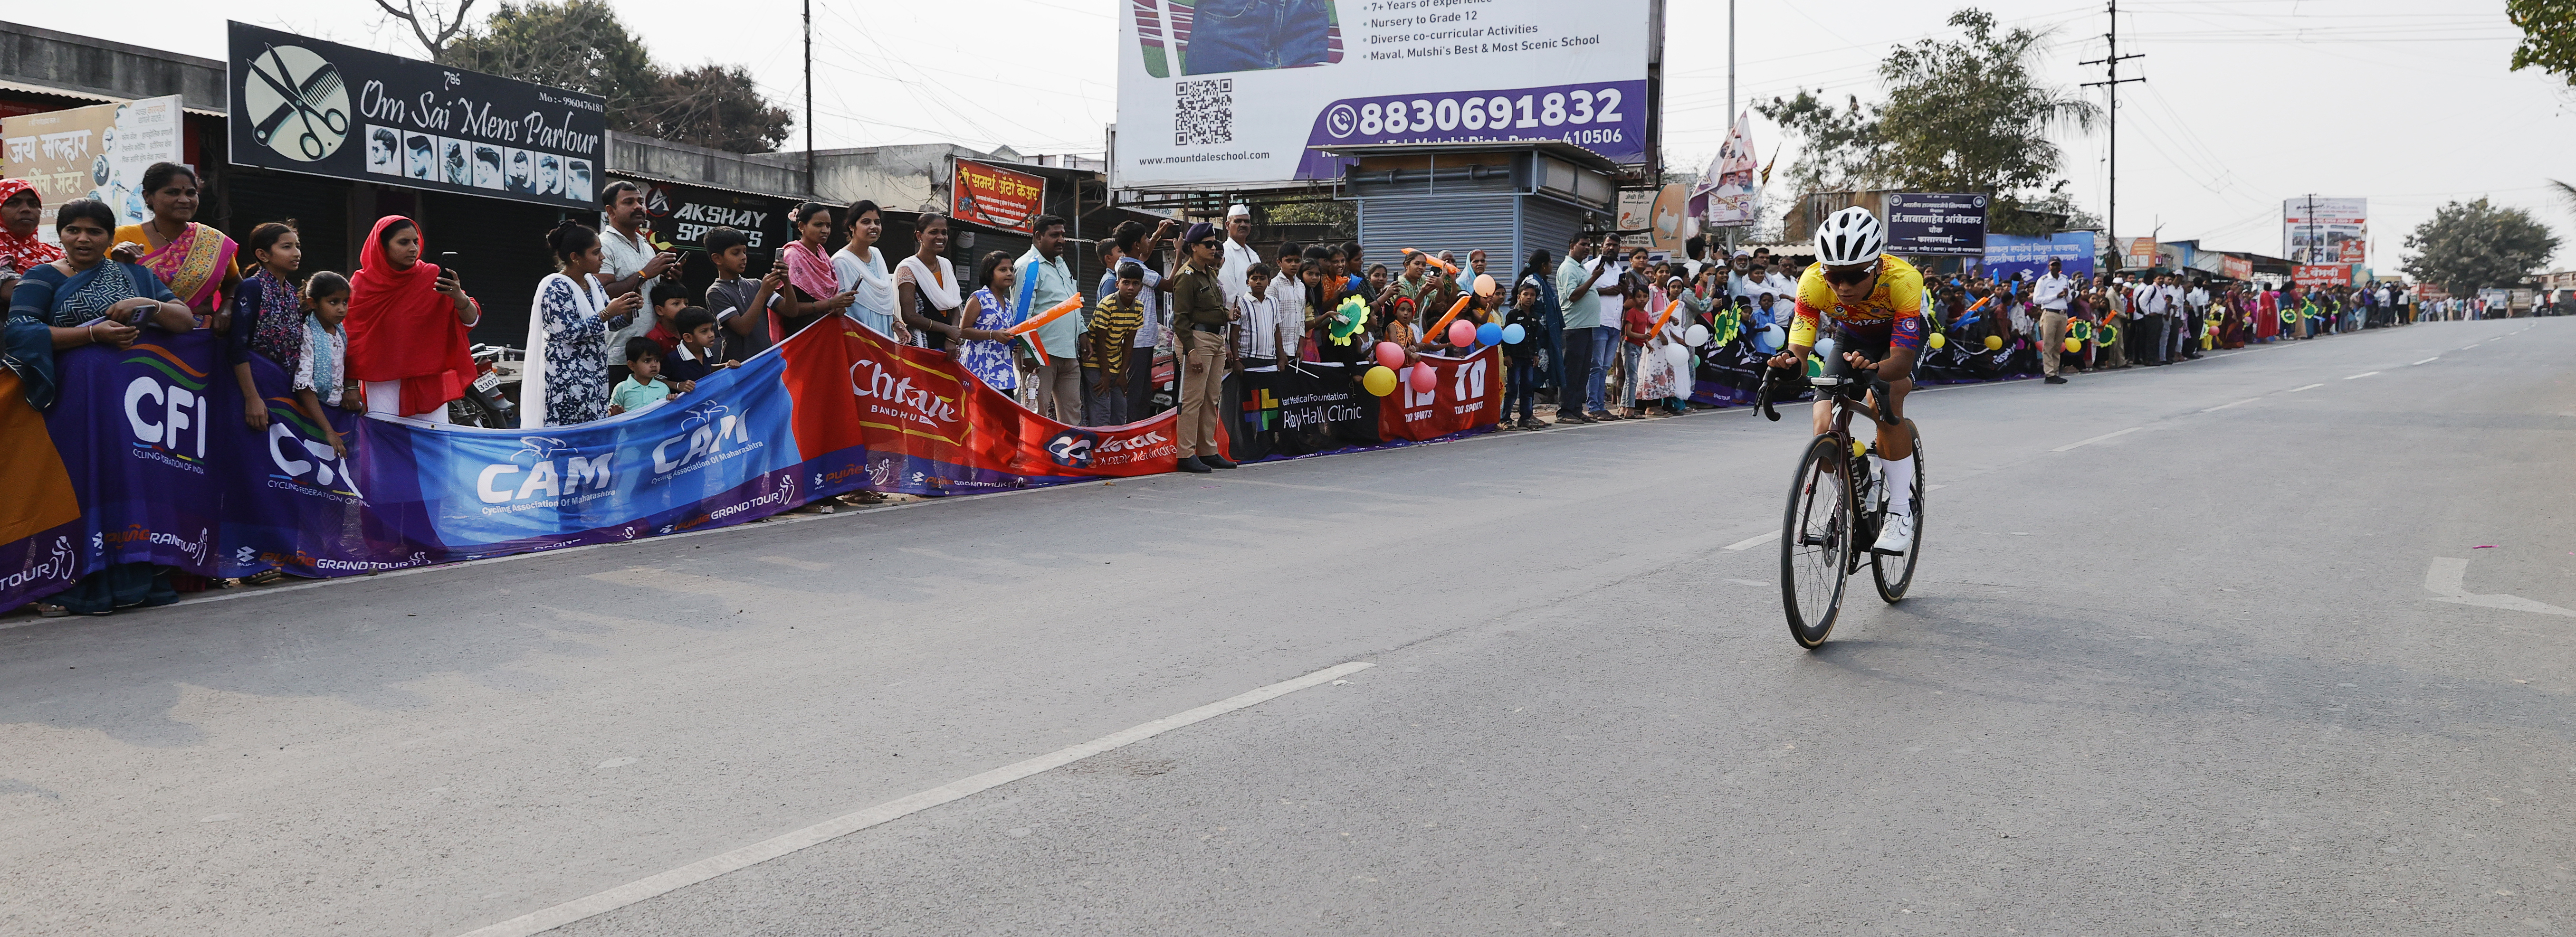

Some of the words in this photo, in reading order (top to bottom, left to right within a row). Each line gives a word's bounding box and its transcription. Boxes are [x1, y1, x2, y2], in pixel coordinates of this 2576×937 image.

[1372, 3, 1383, 11] 7+
[1386, 1, 1416, 10] Years
[1371, 17, 1412, 28] Nursery
[1416, 16, 1426, 24] to
[1430, 13, 1461, 23] Grade
[1465, 11, 1477, 20] 12
[1371, 35, 1410, 44] Diverse
[1413, 28, 1484, 40] co-curricular
[1487, 24, 1538, 36] Activities
[1371, 49, 1404, 60] Maval,
[1407, 47, 1451, 57] Mulshi's
[1454, 45, 1478, 55] Best
[1482, 44, 1488, 53] &
[1492, 42, 1518, 52] Most
[1522, 39, 1557, 50] Scenic
[1562, 34, 1600, 47] School
[444, 71, 460, 90] 786
[539, 92, 553, 102] Mo
[564, 96, 603, 113] 9960476181
[1359, 88, 1622, 135] 8830691832
[361, 80, 405, 123] Om
[412, 91, 452, 130] Sai
[458, 98, 518, 142] Mens
[524, 111, 598, 154] Parlour
[1564, 128, 1622, 145] 410506
[5, 136, 37, 163] जय
[40, 129, 92, 170] मल्हार
[1139, 151, 1269, 165] www.mountdaleschool.com
[53, 166, 85, 196] सेंटर
[972, 174, 996, 191] समर्थ
[673, 202, 767, 228] AKSHAY
[676, 223, 763, 247] SPTS
[478, 378, 497, 390] 3307
[1290, 394, 1309, 404] Medical
[1310, 392, 1348, 402] Foundation
[1465, 401, 1484, 413] SPORTS
[124, 376, 206, 458] CFI
[871, 405, 917, 421] BANDHU
[1301, 406, 1325, 425] Hall
[1328, 403, 1362, 421] Clinic
[1414, 410, 1433, 421] SPORTS
[652, 407, 750, 474] CAM
[673, 461, 710, 477] Association
[719, 440, 763, 462] Maharashtra
[477, 452, 613, 503] CAM
[267, 480, 300, 492] CYCLING
[299, 486, 343, 502] FEDERATION
[482, 506, 512, 515] Cycling
[512, 500, 559, 511] Association
[572, 490, 616, 505] Maharashtra
[711, 503, 750, 520] GRAND
[750, 492, 779, 508] TOUR
[317, 558, 369, 570] GRAND
[0, 563, 50, 591] TOUR
